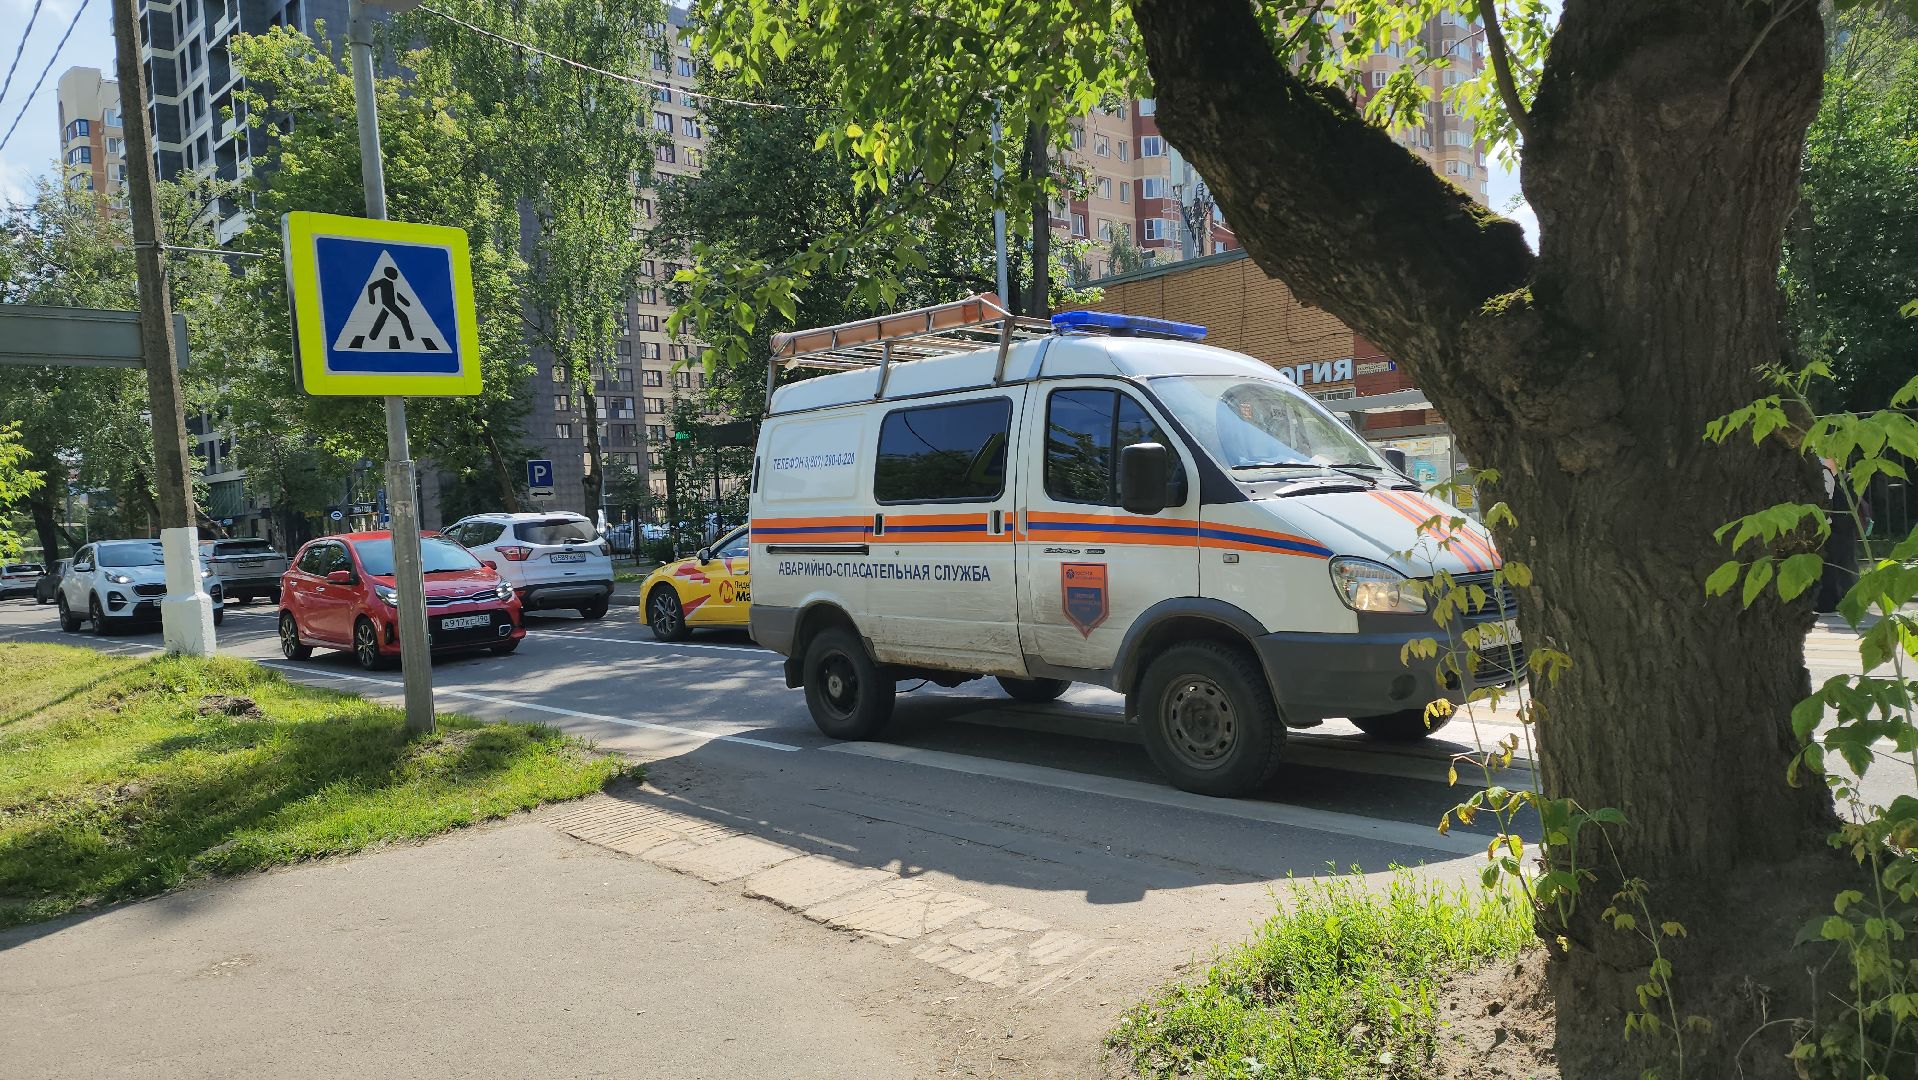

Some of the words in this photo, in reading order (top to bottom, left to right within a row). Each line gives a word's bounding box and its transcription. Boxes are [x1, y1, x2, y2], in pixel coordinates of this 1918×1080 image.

[774, 457, 803, 470] ТЕЛЕФОН
[534, 465, 547, 483] P
[778, 558, 930, 581] АВАРИЙНО-СПАСАТЕЛЬНАЯ
[934, 564, 991, 582] СЛУЖБА
